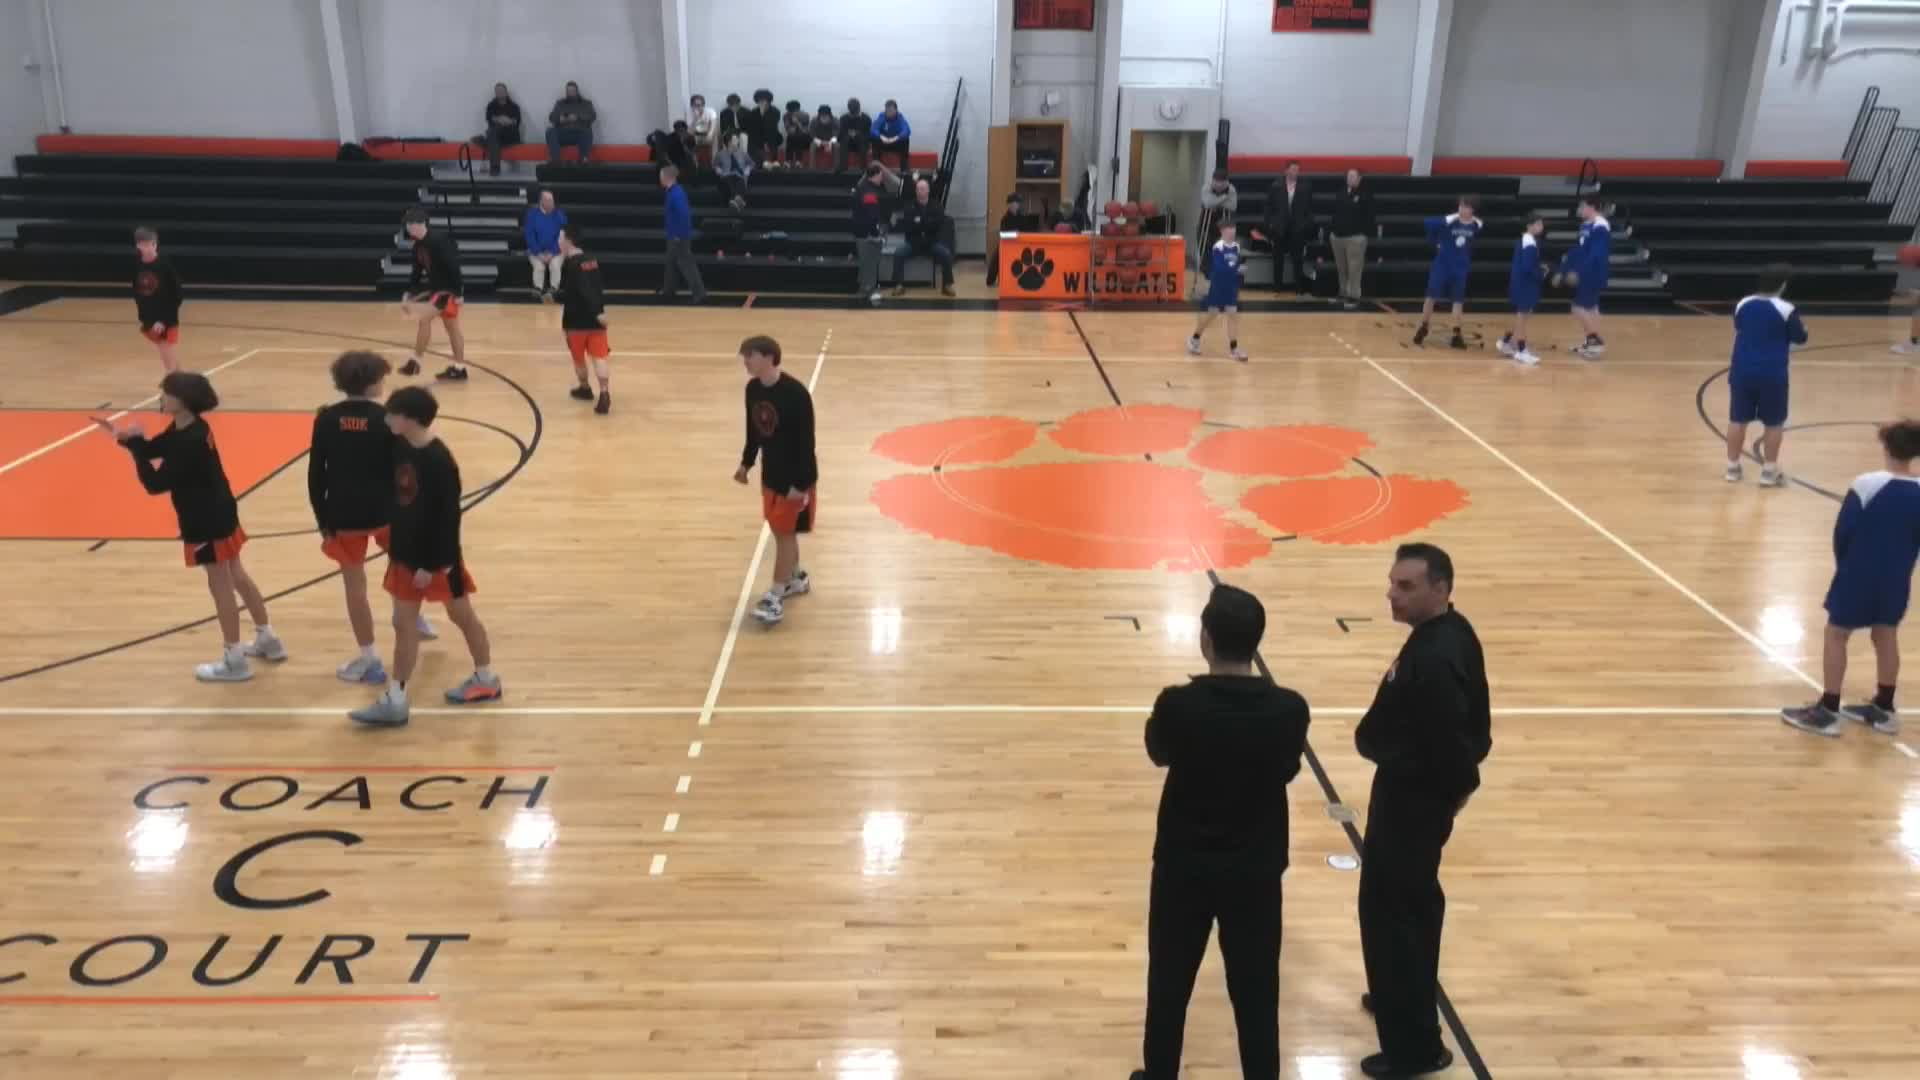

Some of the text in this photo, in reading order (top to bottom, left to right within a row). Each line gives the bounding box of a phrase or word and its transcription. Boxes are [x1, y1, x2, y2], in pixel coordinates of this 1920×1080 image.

[132, 775, 550, 810] COACH
[212, 829, 364, 910] C
[0, 933, 471, 986] COURT
